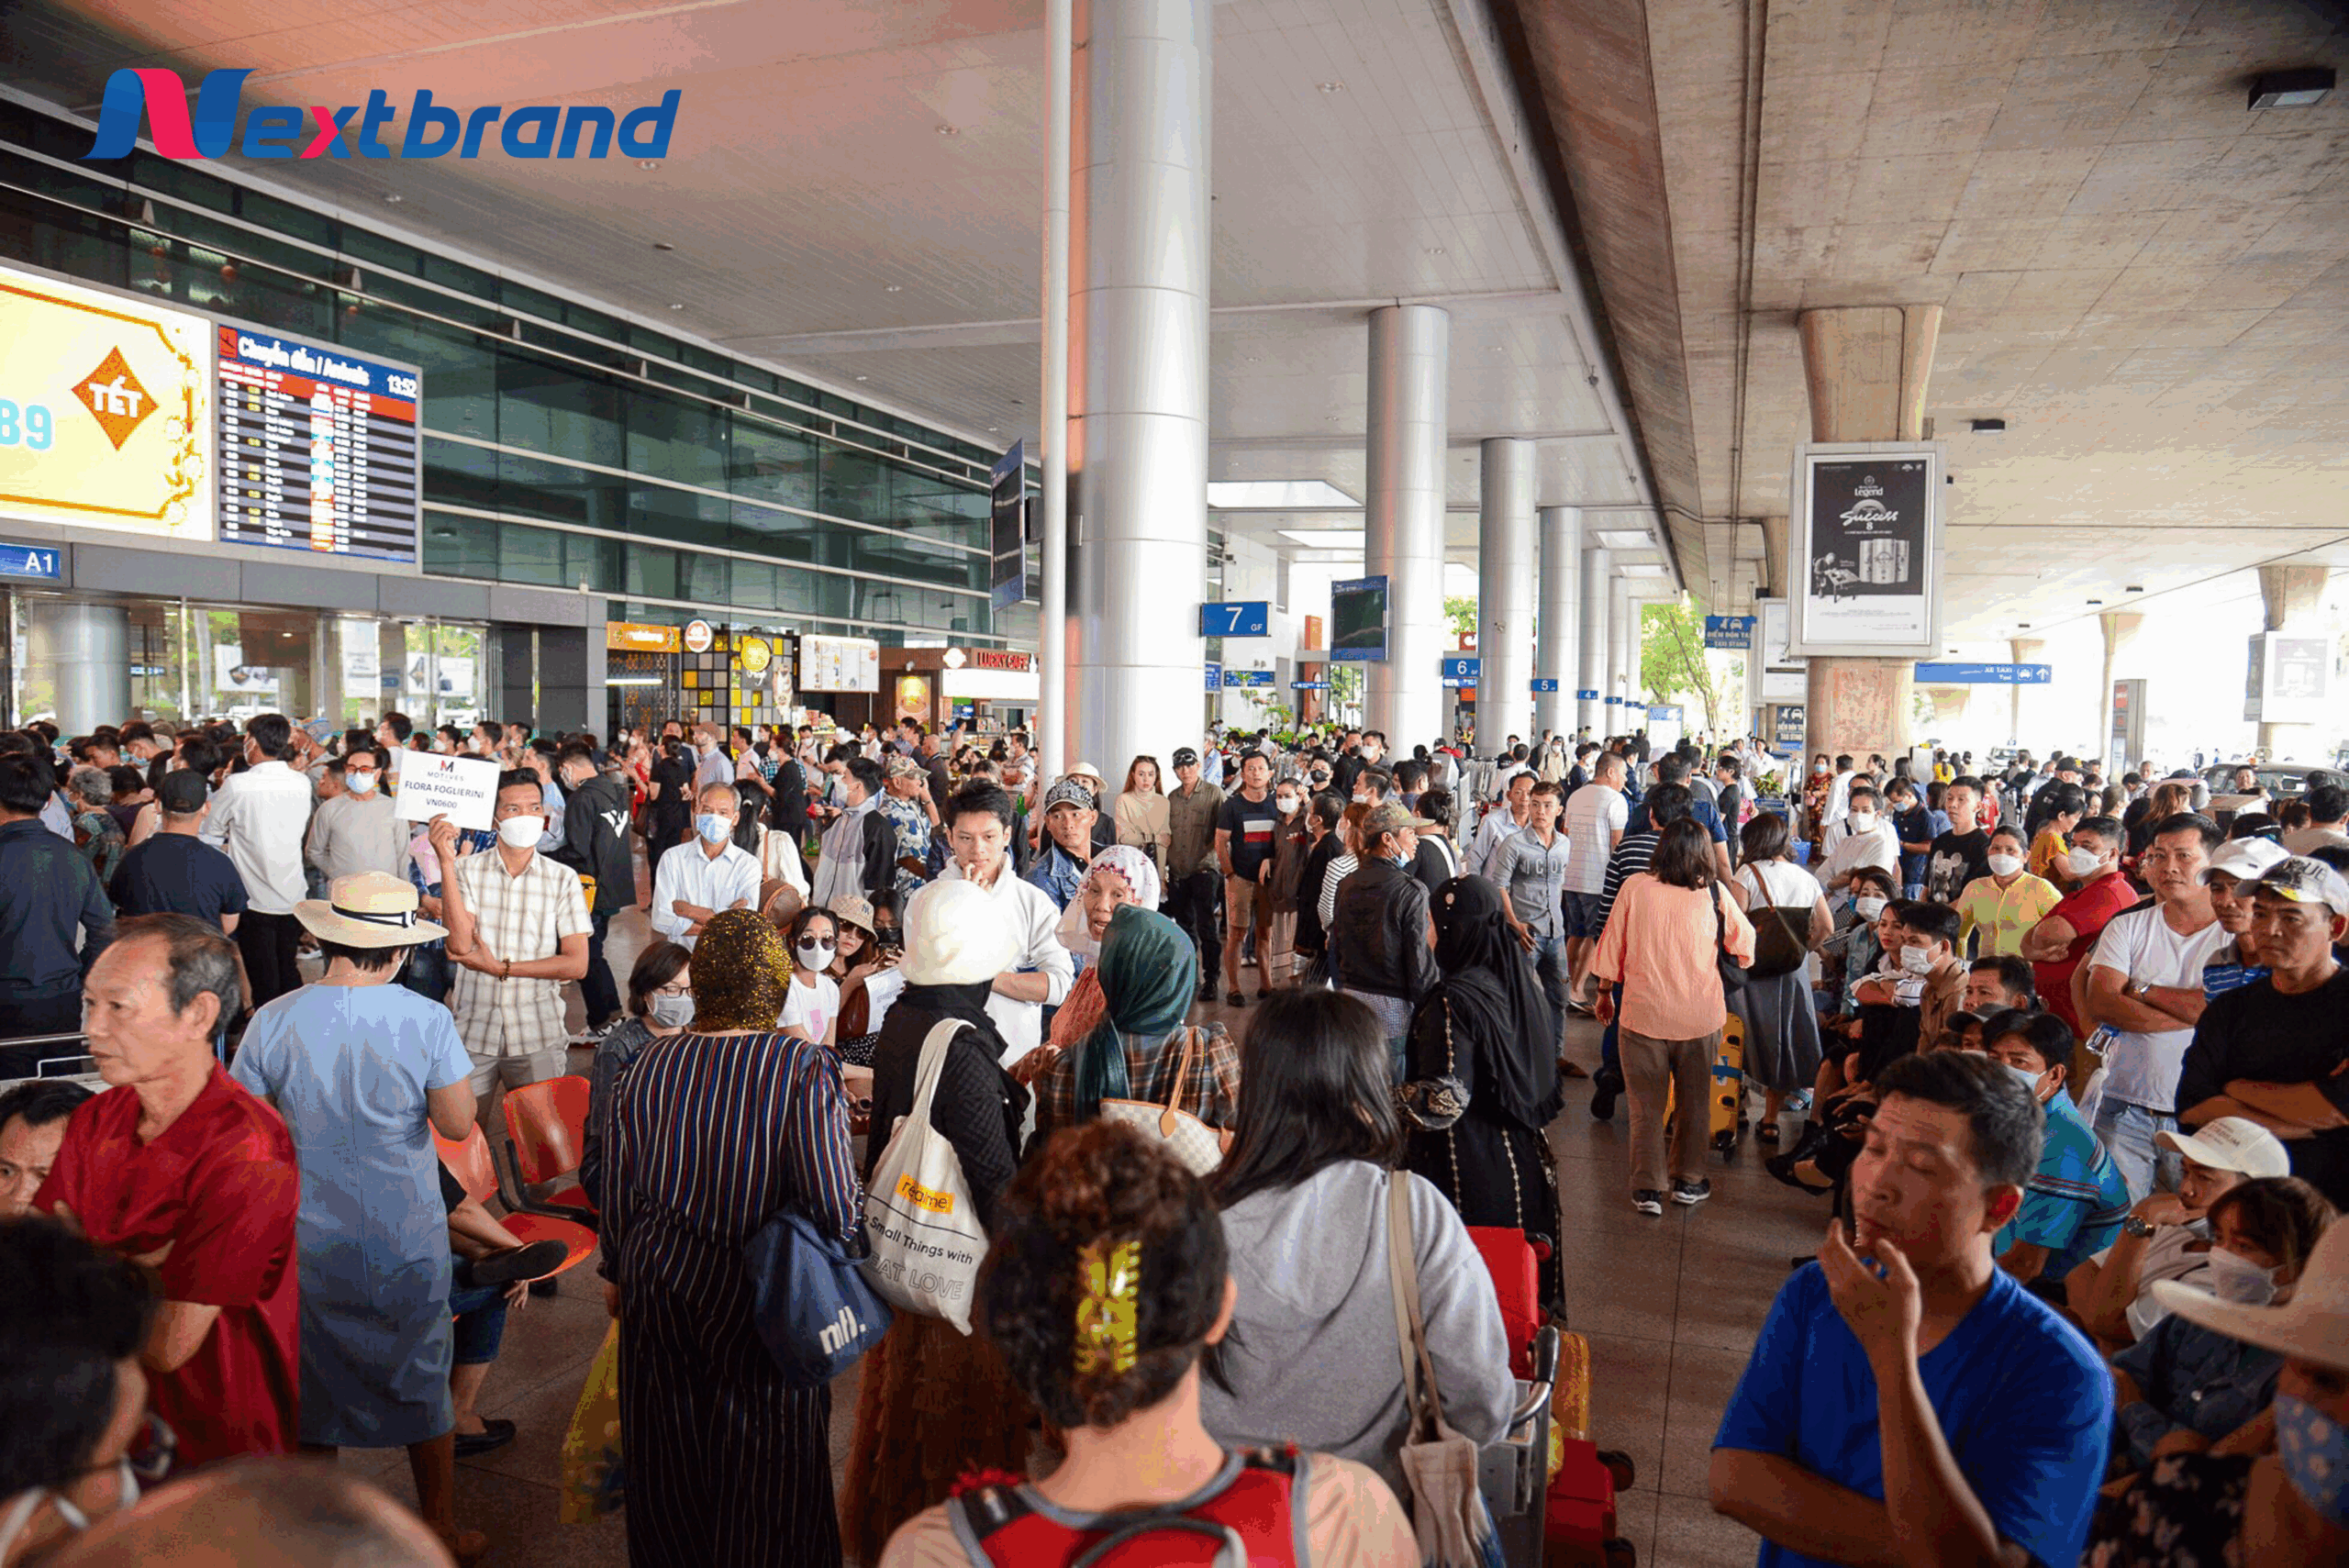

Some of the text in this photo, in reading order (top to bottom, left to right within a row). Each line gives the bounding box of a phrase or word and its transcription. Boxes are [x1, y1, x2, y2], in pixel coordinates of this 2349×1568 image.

[1854, 486, 1884, 497] Legend
[1865, 521, 1874, 531] 8
[25, 551, 53, 573] A1
[1226, 606, 1264, 632] 7 GF
[977, 651, 1008, 668] LUCKY
[1457, 661, 1467, 674] 6
[1542, 681, 1549, 691] 5
[427, 771, 464, 782] MOTIVES
[405, 780, 484, 799] FLORA FOGLIERINI
[426, 797, 458, 809] VN0600
[901, 1182, 949, 1210] reame
[870, 1216, 901, 1243] Small
[903, 1235, 944, 1258] Things
[947, 1248, 974, 1265] with
[907, 1269, 964, 1301] LOVE
